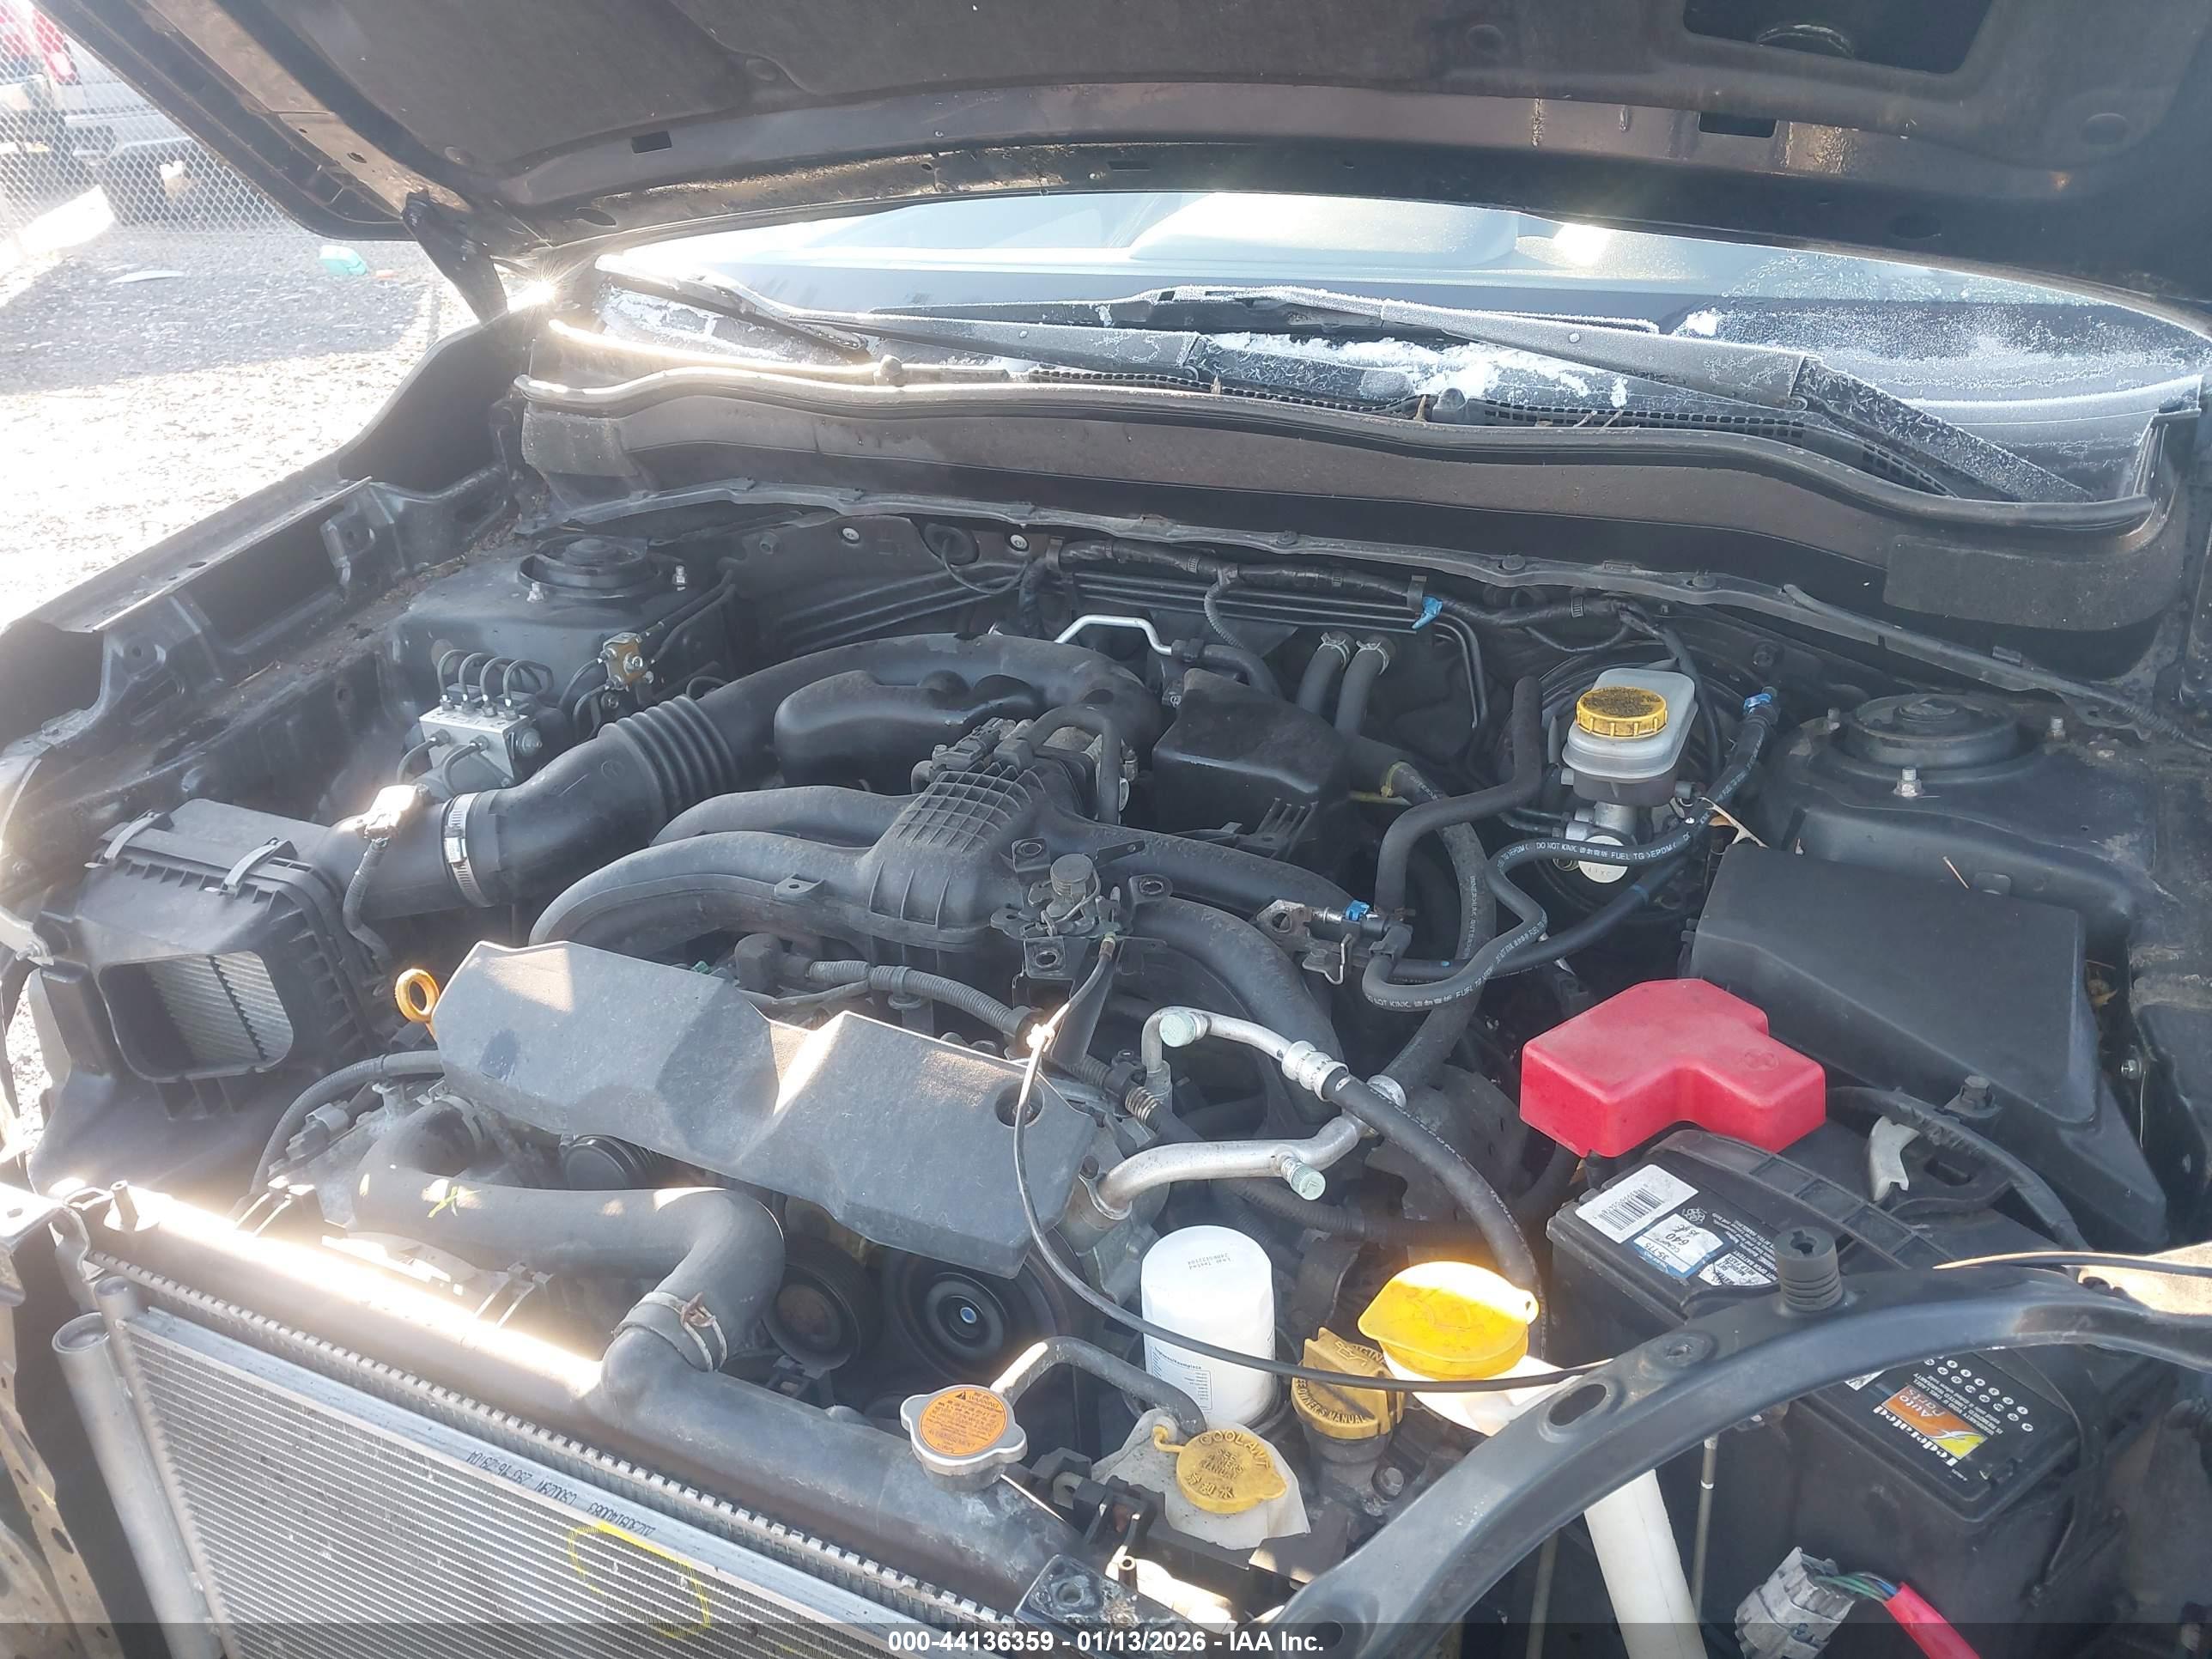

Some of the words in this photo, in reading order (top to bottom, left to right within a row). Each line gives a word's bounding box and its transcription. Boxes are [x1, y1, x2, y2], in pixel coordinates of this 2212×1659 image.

[1611, 851, 1631, 860] FUEL
[1897, 1394, 1932, 1419] Auto
[1904, 1389, 1946, 1417] Parts
[1328, 1409, 1366, 1425] MANUAL
[1199, 1429, 1271, 1469] COOLANT
[1873, 1403, 1958, 1469] Federated
